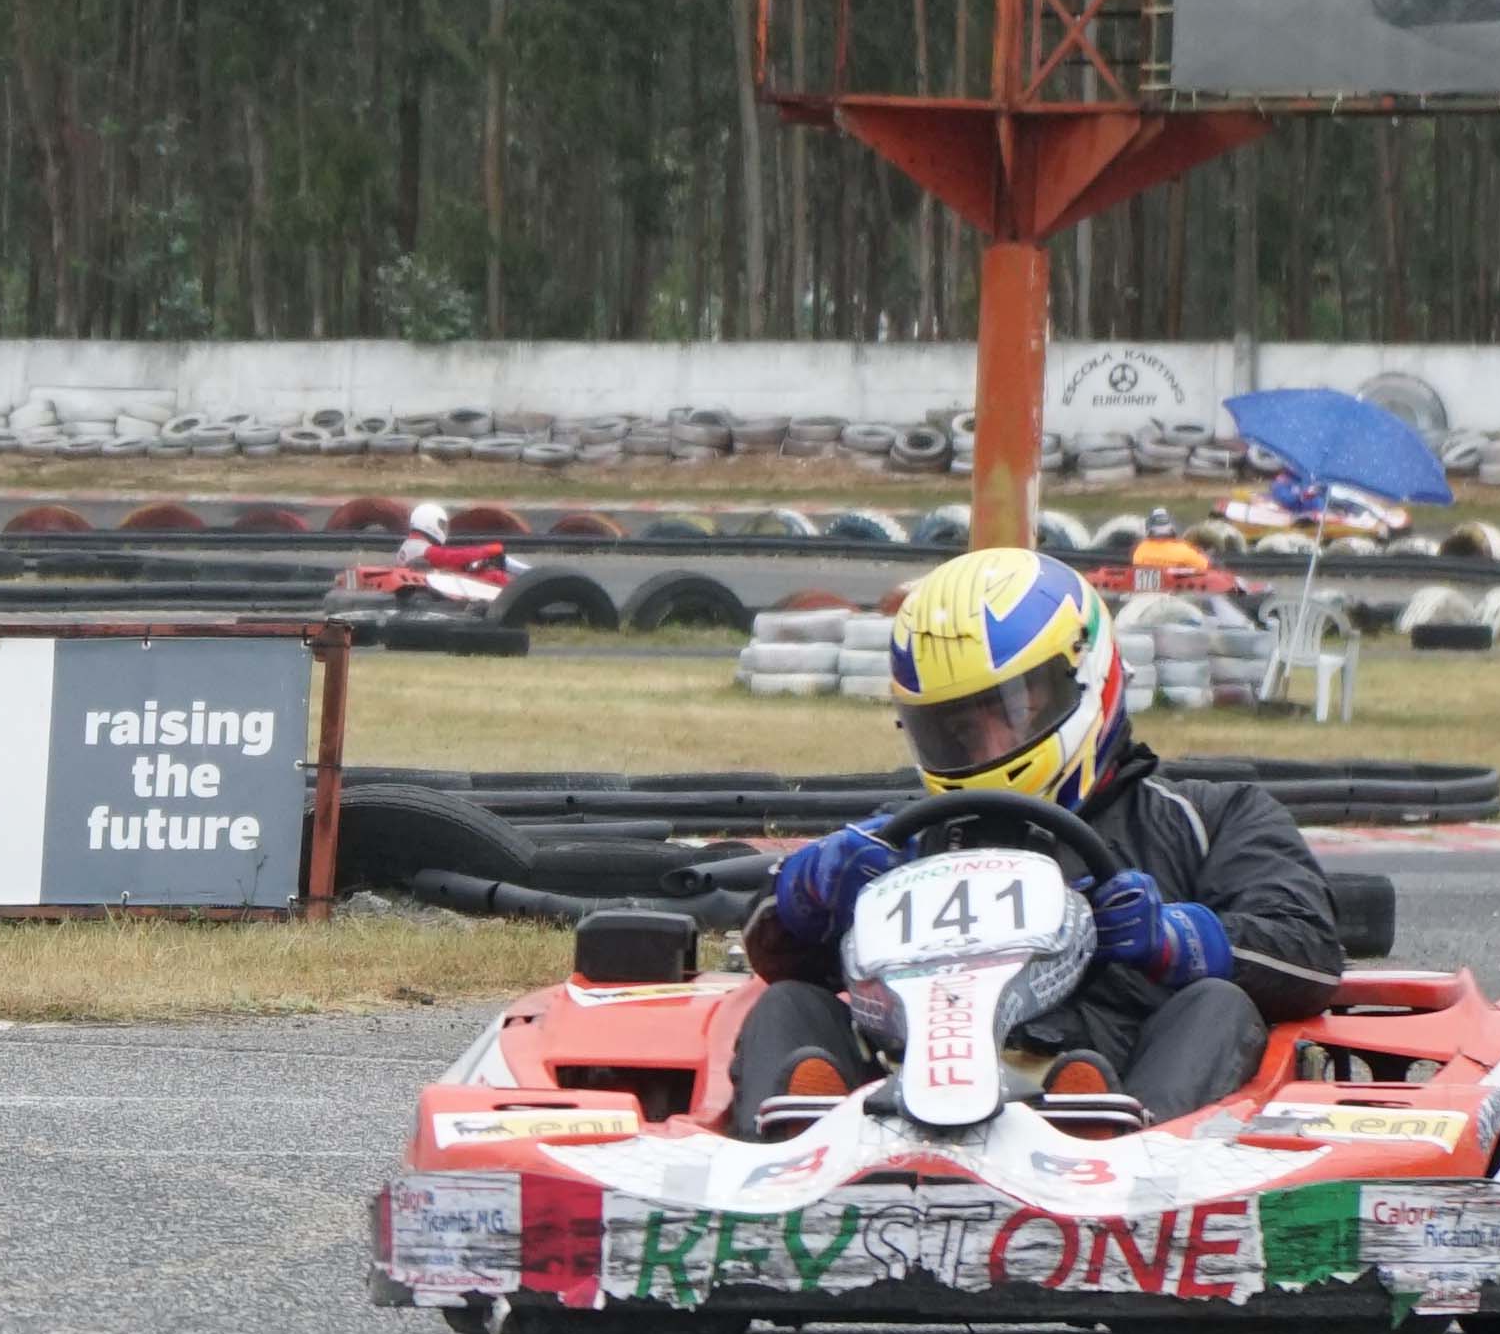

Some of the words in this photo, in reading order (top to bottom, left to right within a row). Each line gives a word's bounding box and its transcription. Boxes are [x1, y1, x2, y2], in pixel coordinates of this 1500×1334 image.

[84, 700, 275, 756] raising
[131, 754, 221, 798] the
[87, 805, 260, 851] future
[886, 878, 1026, 945] 141
[1350, 1115, 1450, 1138] eni
